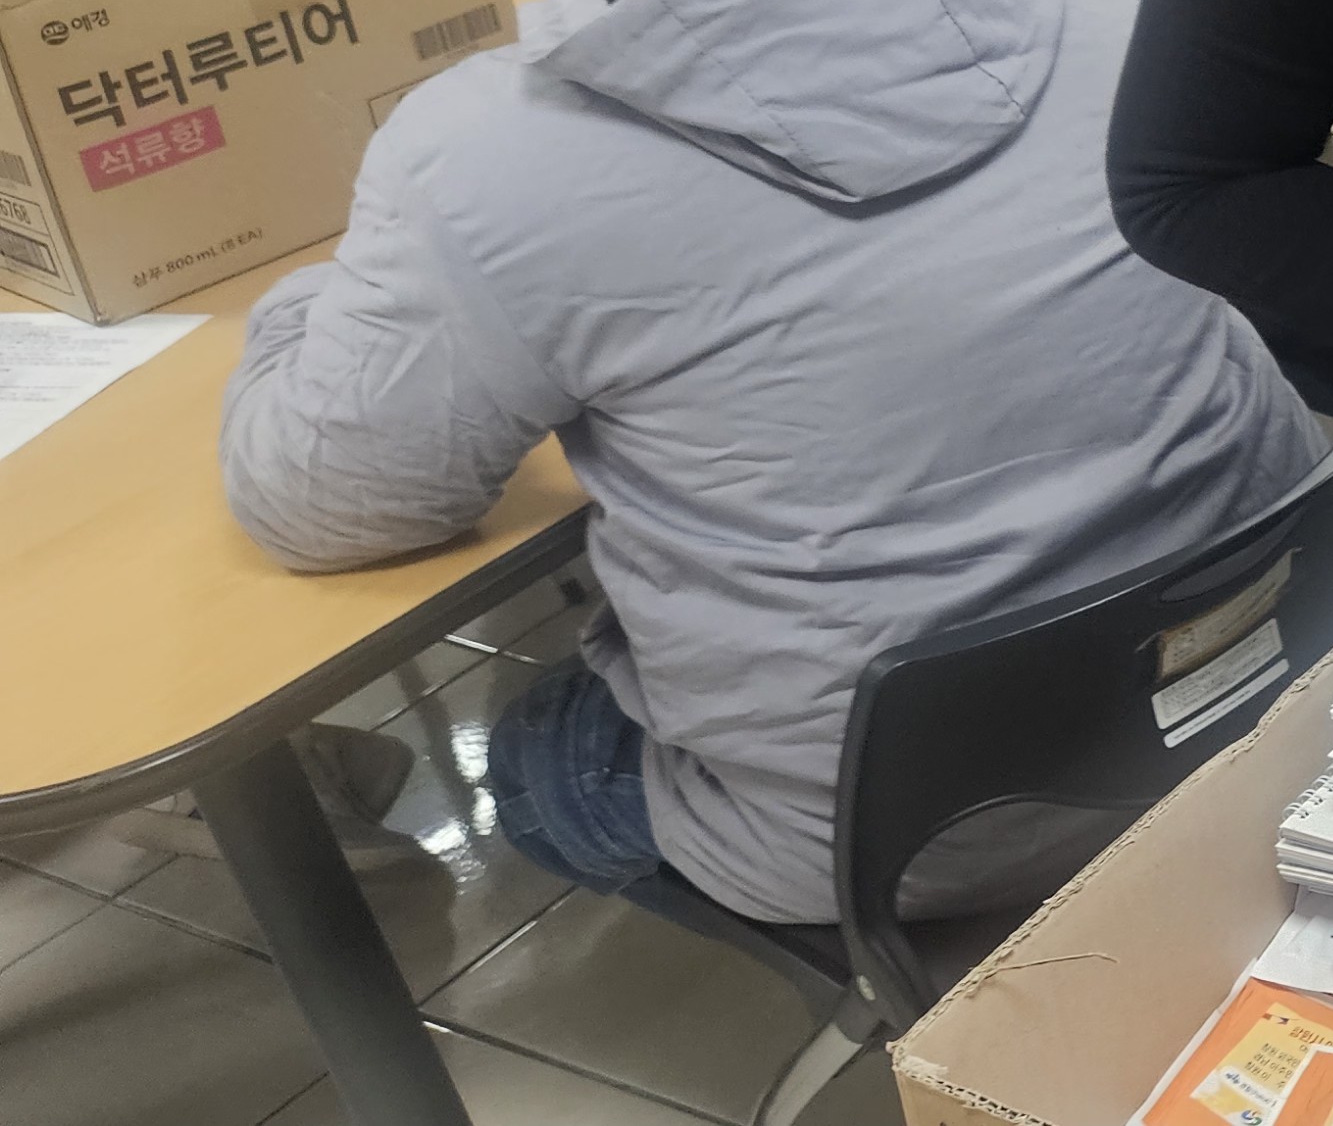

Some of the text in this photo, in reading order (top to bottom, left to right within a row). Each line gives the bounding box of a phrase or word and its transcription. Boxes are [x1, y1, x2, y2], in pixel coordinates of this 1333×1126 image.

[71, 9, 110, 32] 애경
[100, 117, 206, 176] 석류향
[166, 254, 194, 273] 800
